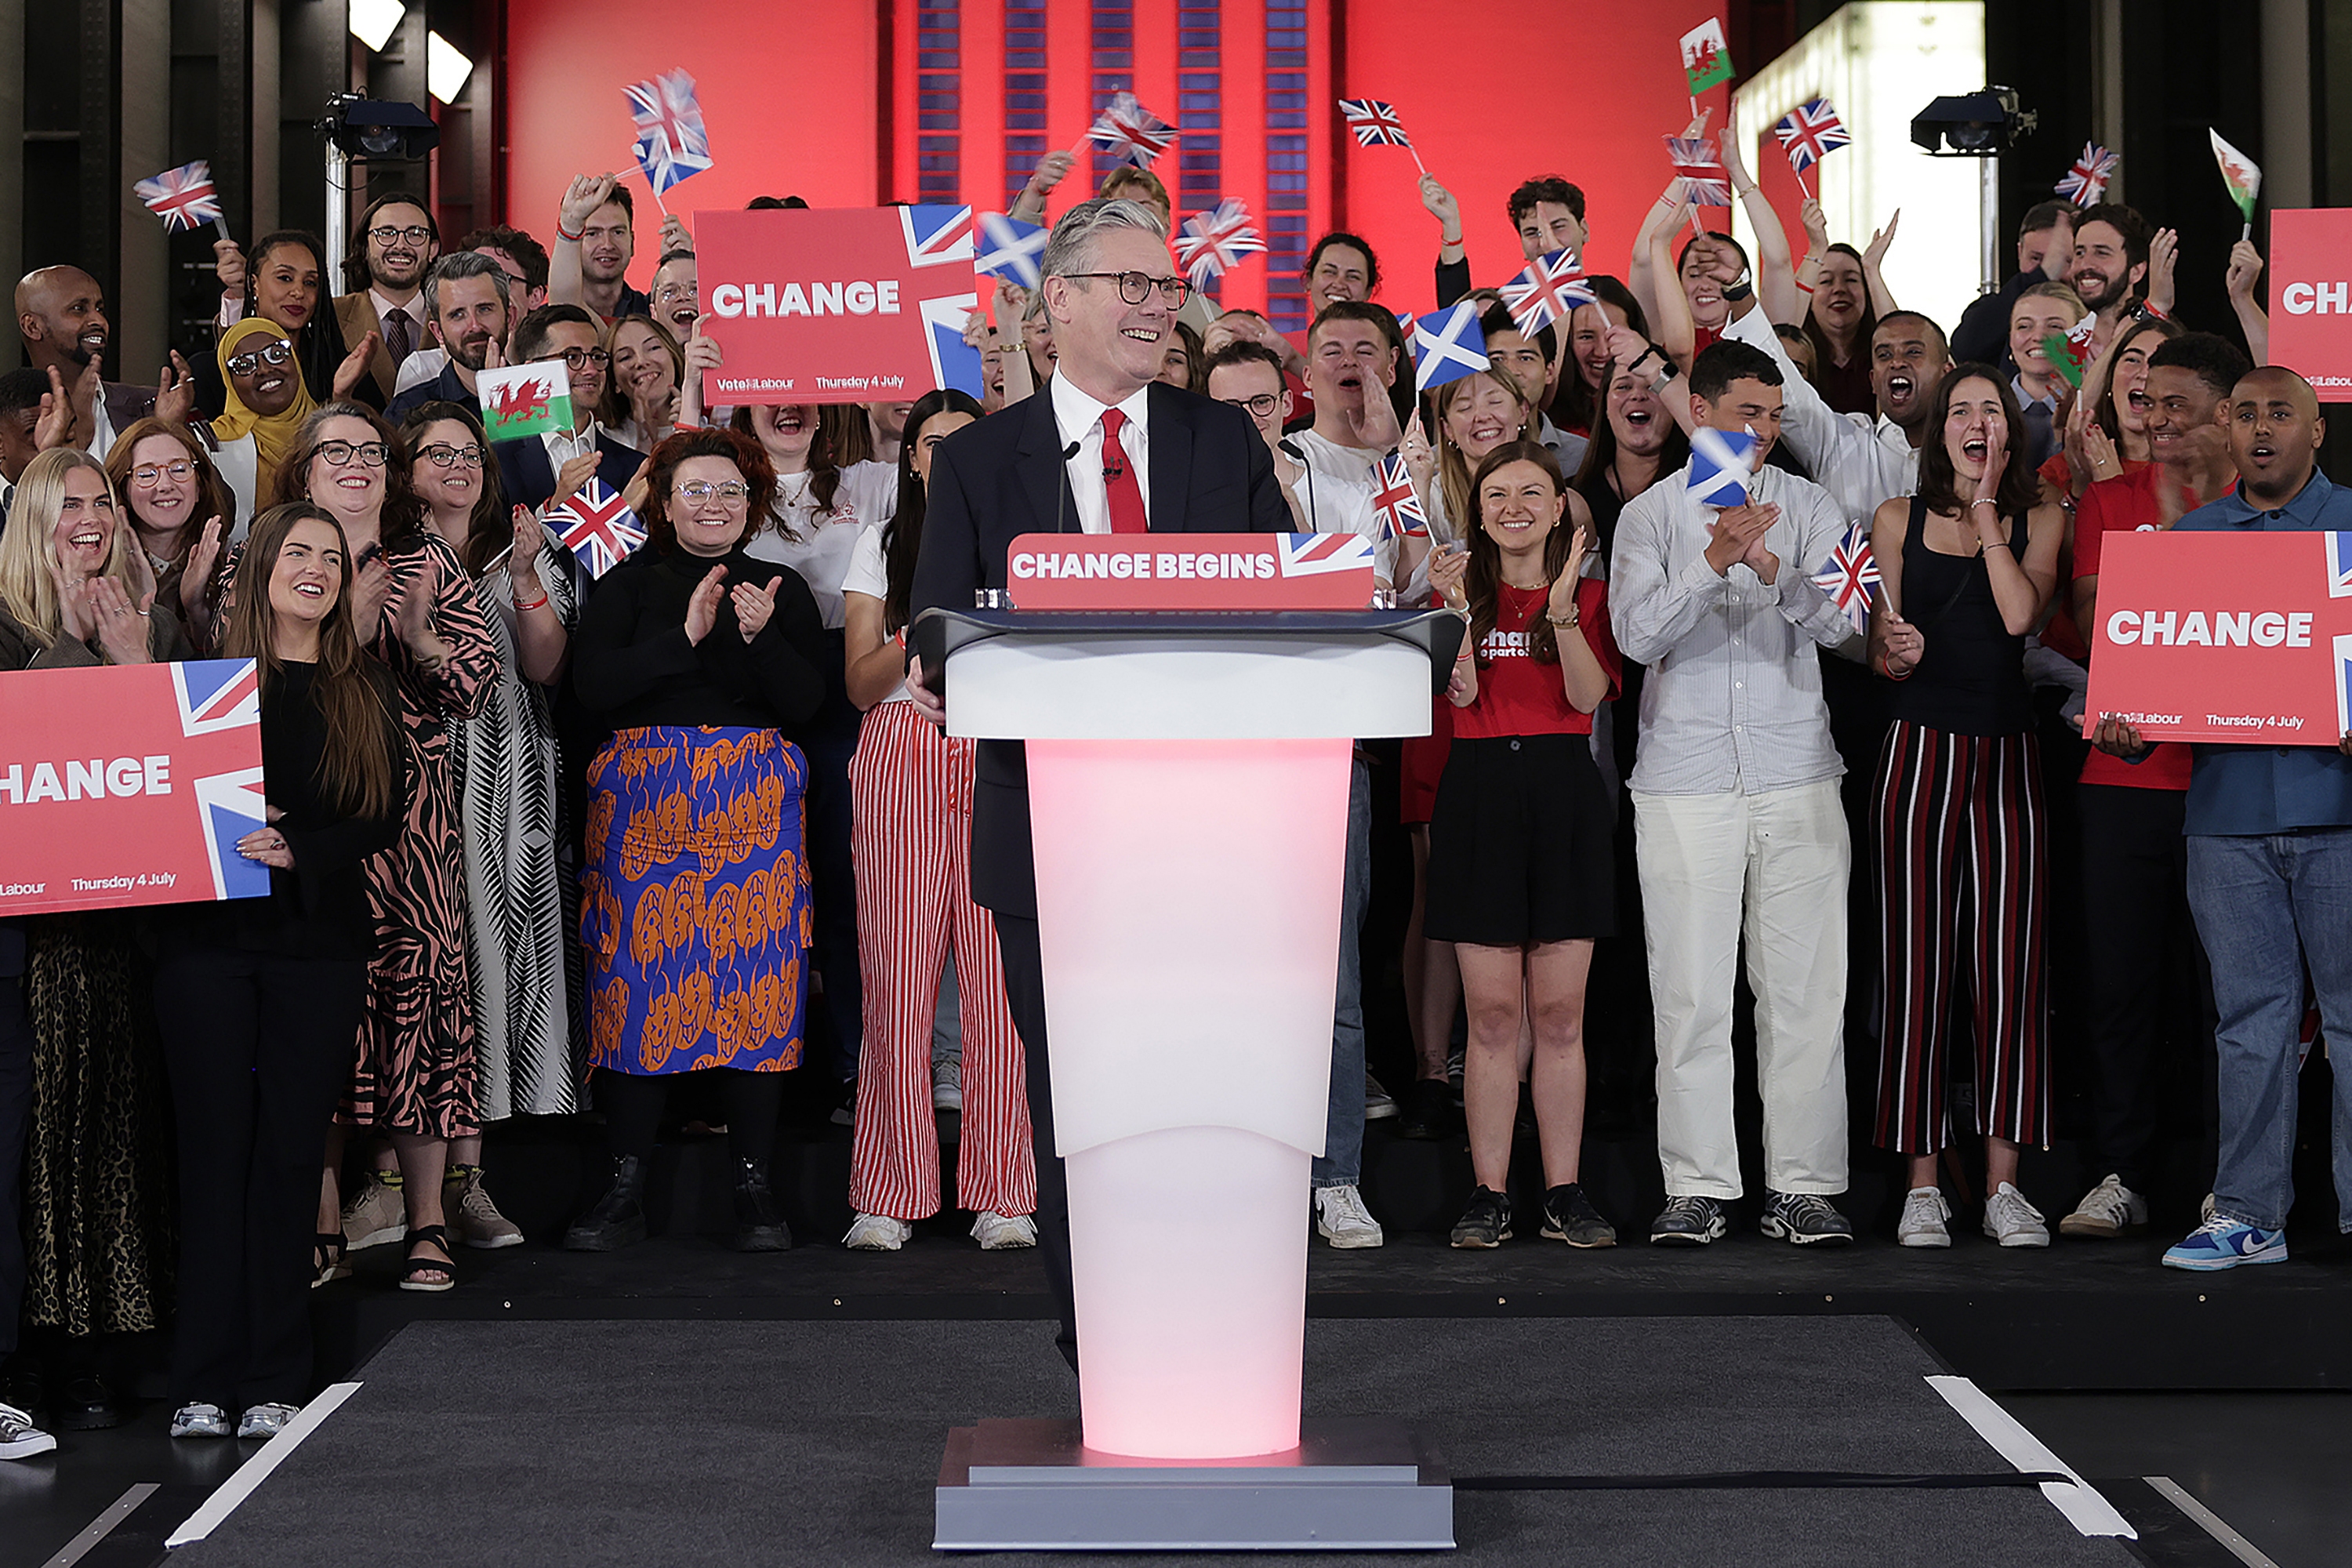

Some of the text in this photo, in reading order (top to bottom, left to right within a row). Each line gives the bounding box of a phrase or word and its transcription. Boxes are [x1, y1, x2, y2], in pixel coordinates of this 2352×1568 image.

[712, 280, 901, 318] CHANGE
[2282, 281, 2352, 315] CH
[717, 378, 794, 391] Vote Labour
[815, 374, 904, 390] Thursday 4 July
[1012, 553, 1276, 579] CHANGE BEGINS
[2107, 610, 2314, 648] CHANGE
[1489, 647, 1516, 659] part
[2140, 713, 2183, 724] Labour
[2205, 714, 2304, 731] Thursday 4 July
[71, 872, 176, 891] Thursday 4 July
